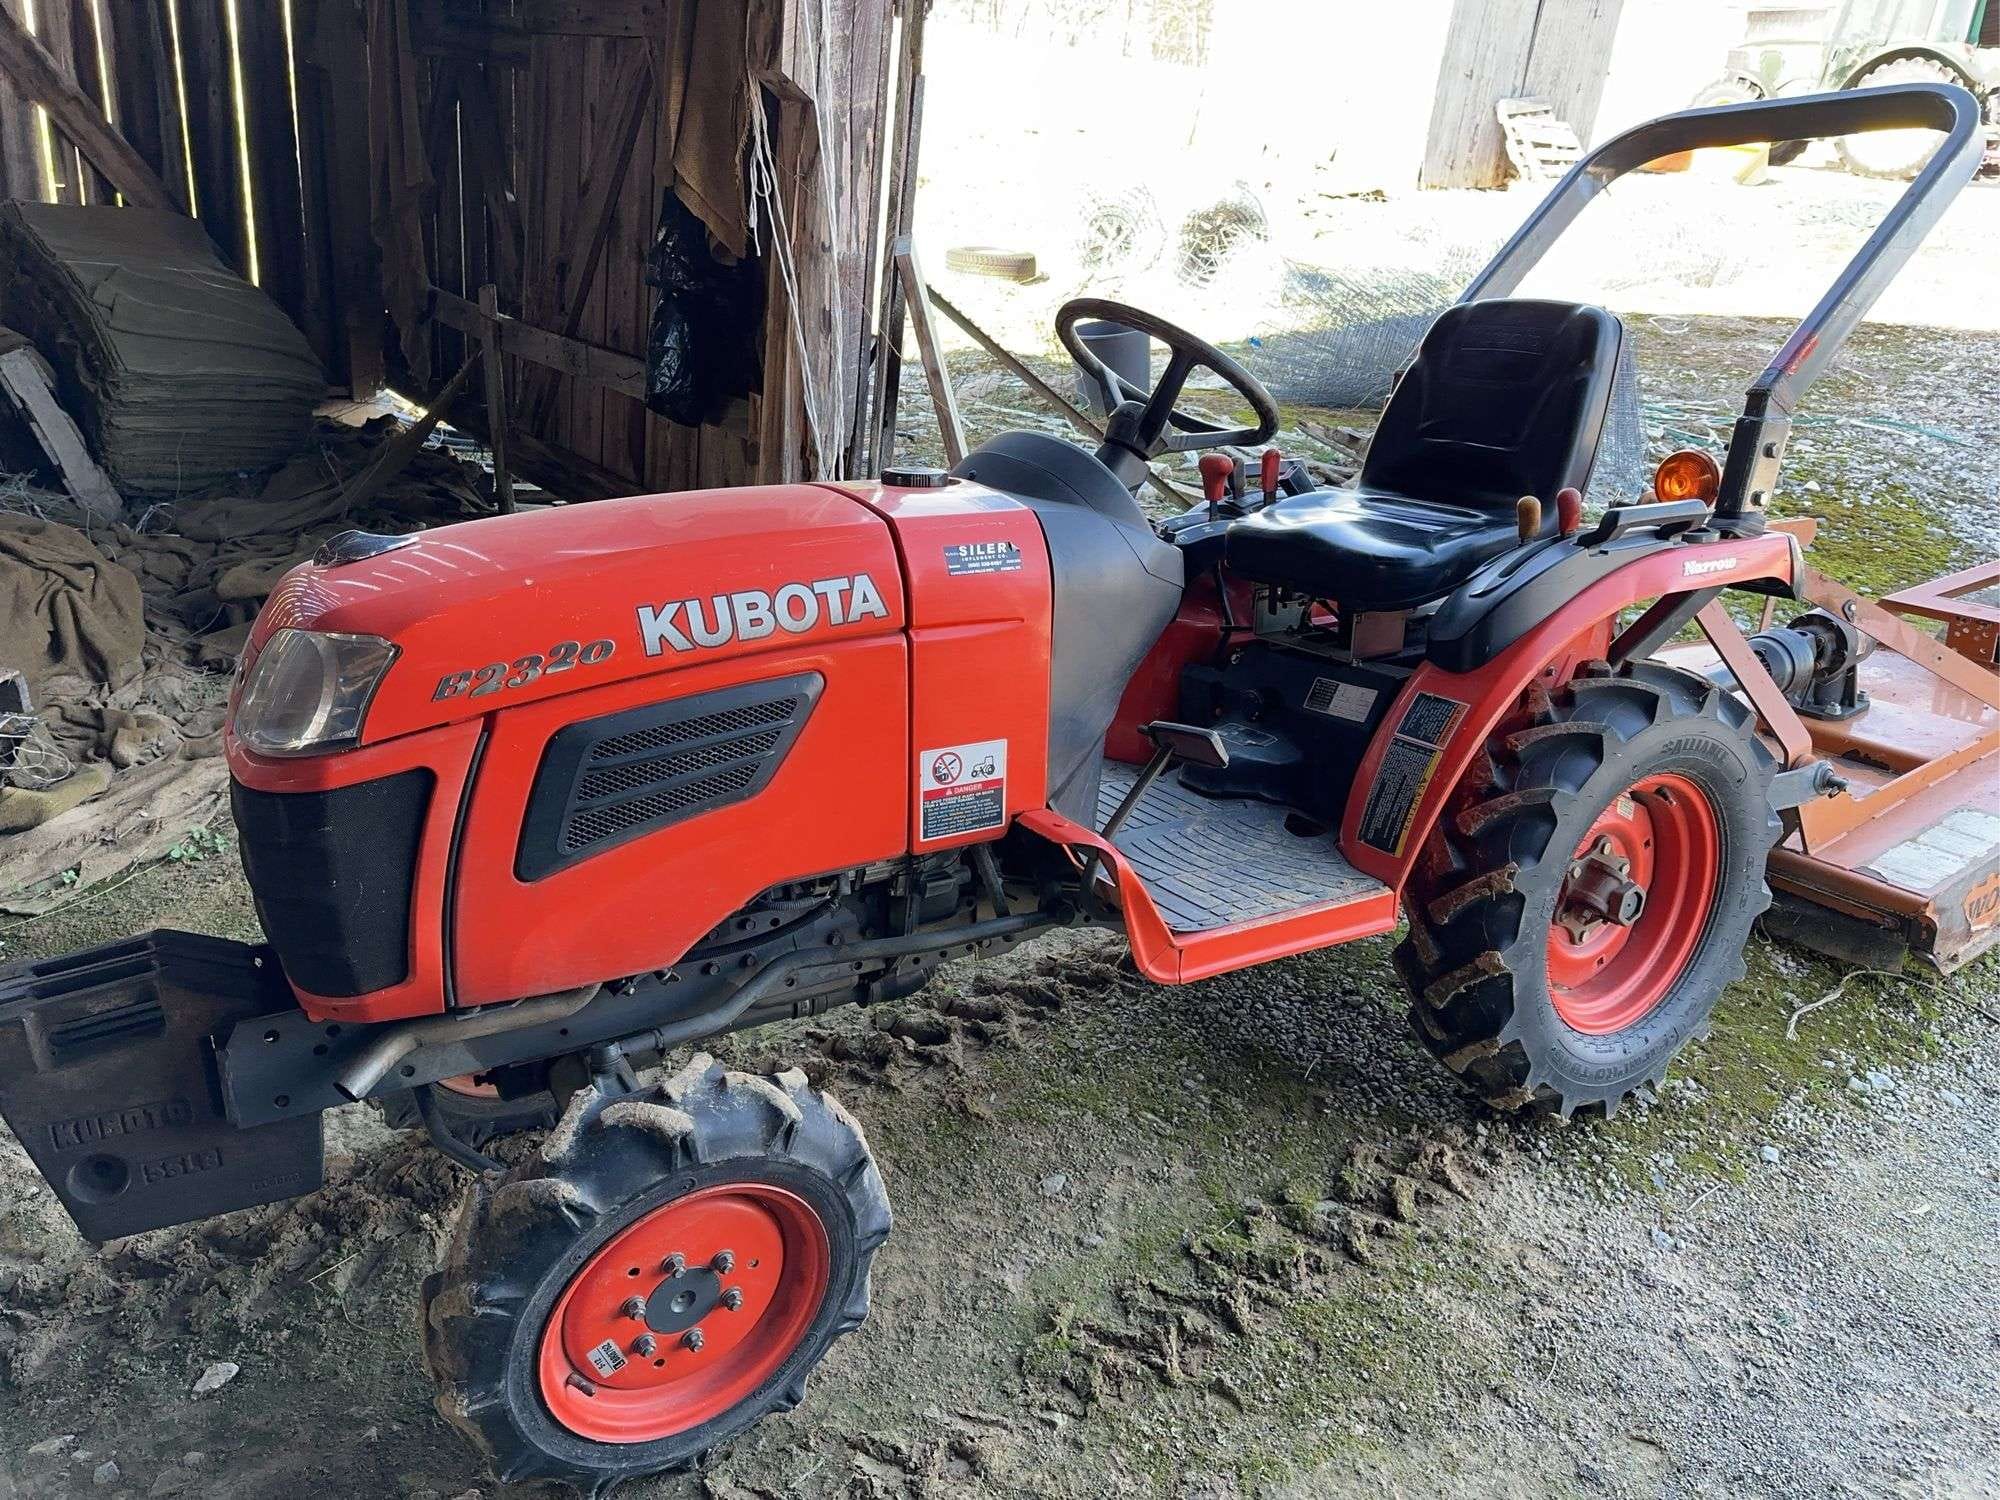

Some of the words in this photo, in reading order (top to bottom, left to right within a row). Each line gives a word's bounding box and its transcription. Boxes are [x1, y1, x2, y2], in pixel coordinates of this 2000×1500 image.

[959, 542, 1007, 557] SILER
[1683, 558, 1737, 576] Narrow
[636, 573, 890, 658] KUBOTA
[431, 639, 616, 702] B2320
[954, 783, 983, 794] DANGER
[51, 1096, 194, 1151] KUBOTA
